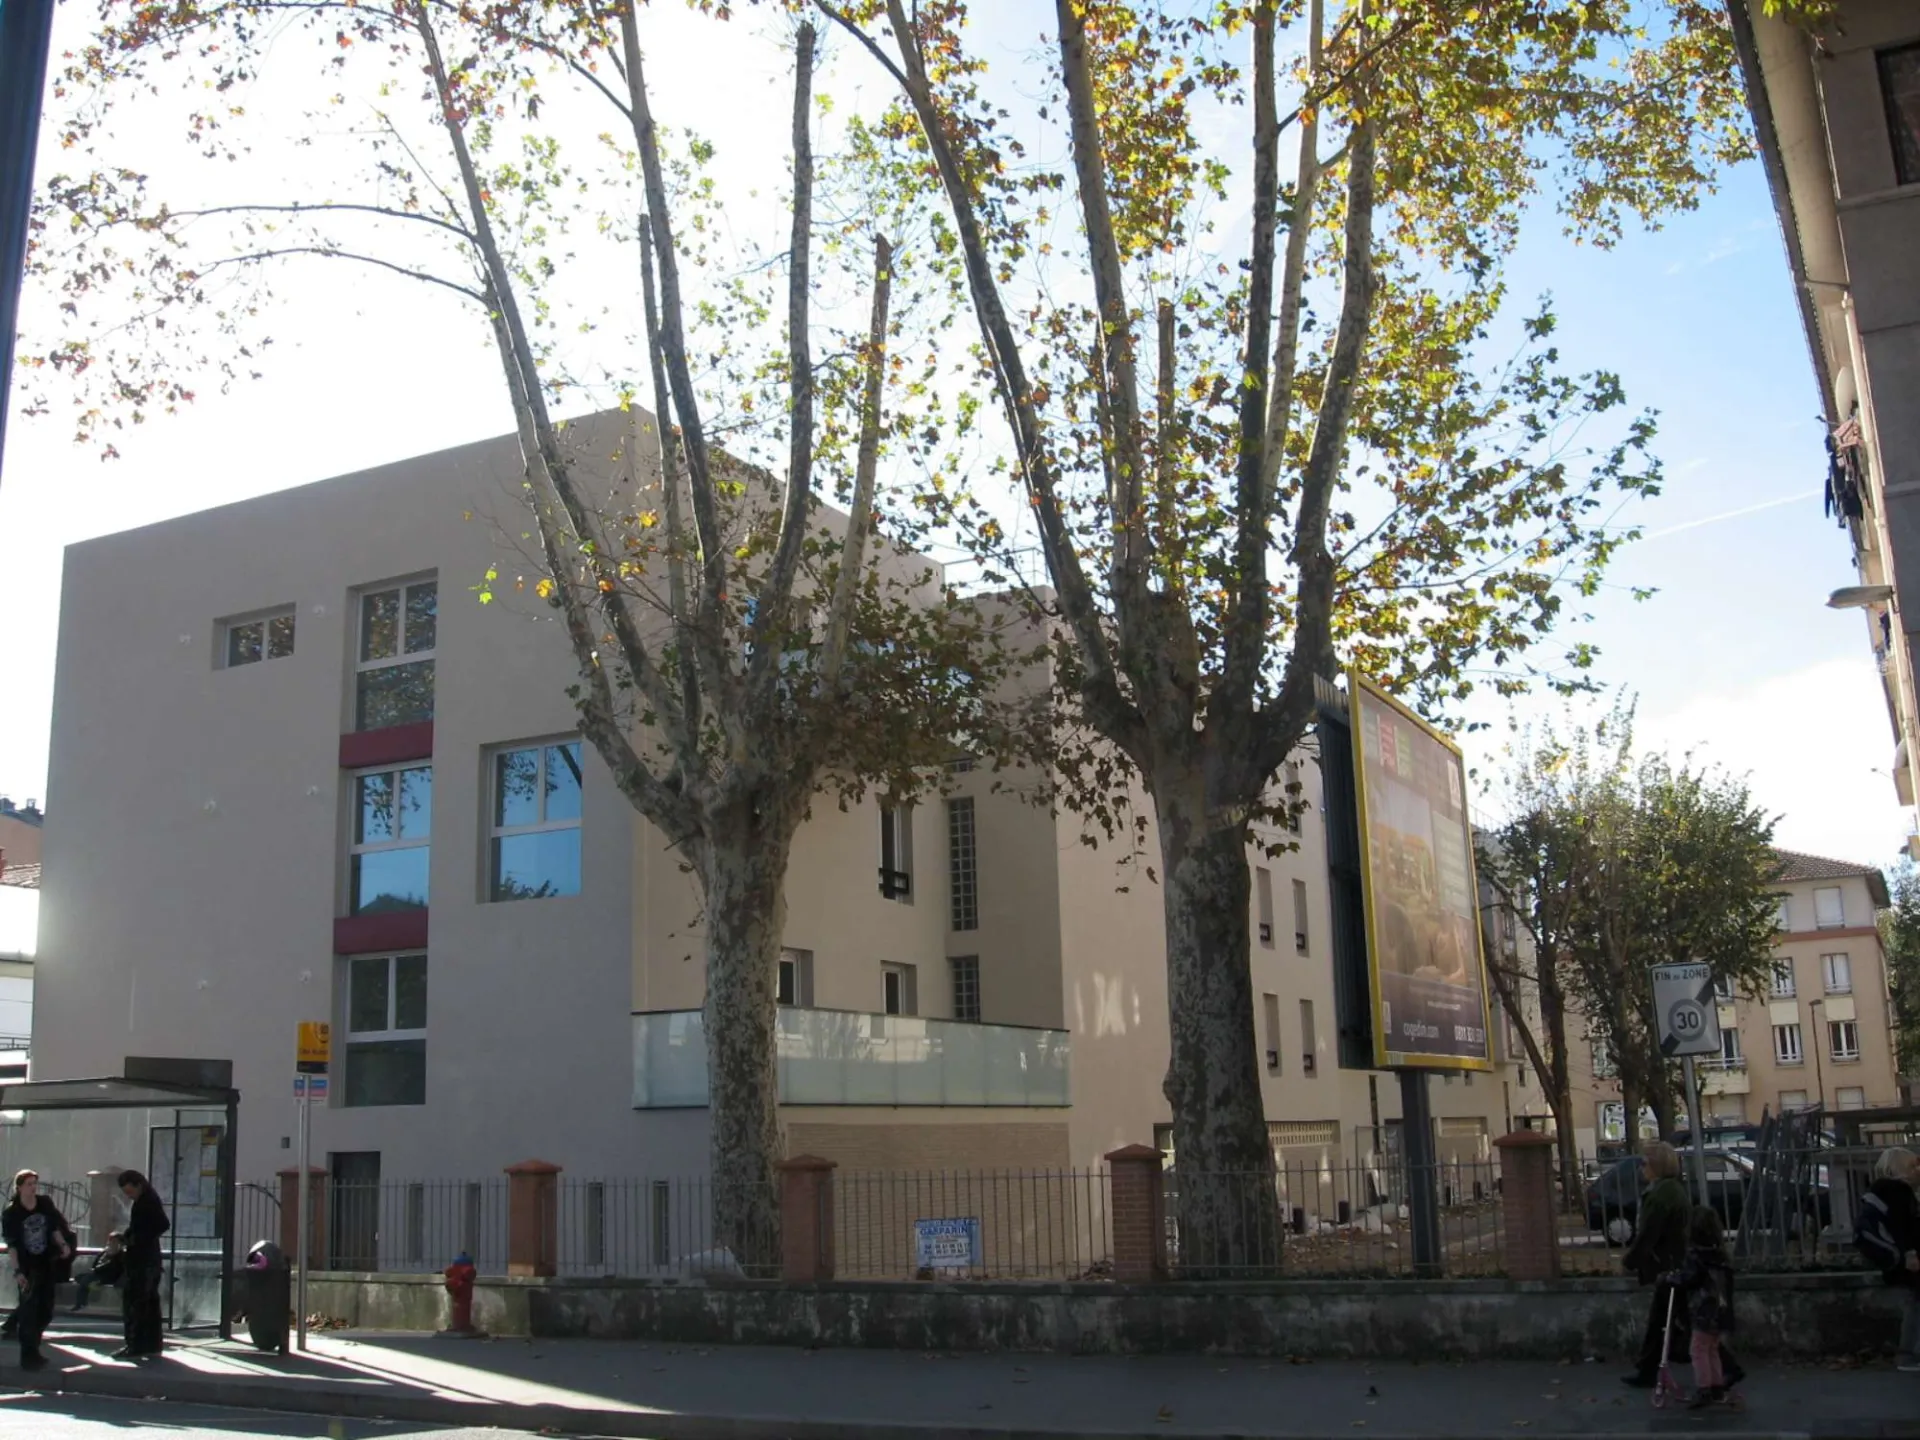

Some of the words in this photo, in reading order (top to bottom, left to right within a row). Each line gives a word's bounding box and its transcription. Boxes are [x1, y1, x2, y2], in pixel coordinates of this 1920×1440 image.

[1655, 971, 1671, 981] FIN
[1682, 968, 1709, 980] ZONE
[1676, 1011, 1699, 1030] 30
